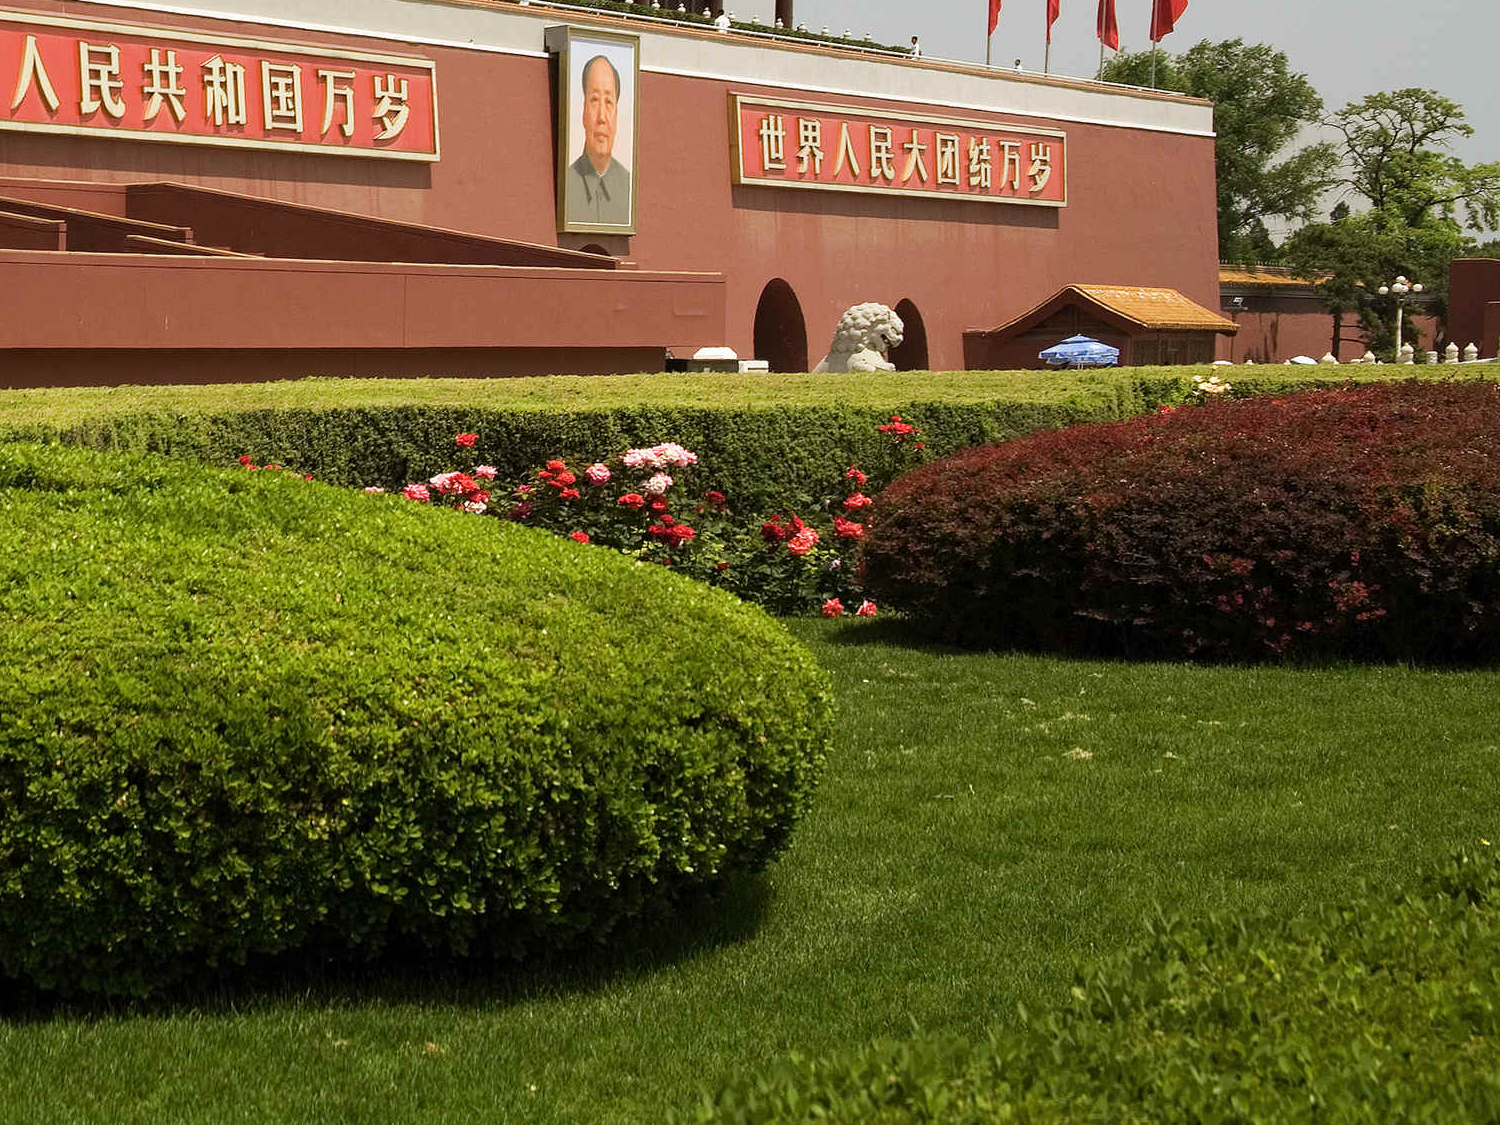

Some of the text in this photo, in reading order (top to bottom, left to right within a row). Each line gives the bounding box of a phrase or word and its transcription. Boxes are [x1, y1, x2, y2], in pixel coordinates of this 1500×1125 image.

[759, 114, 1052, 192] 世界人民大团结万岁
